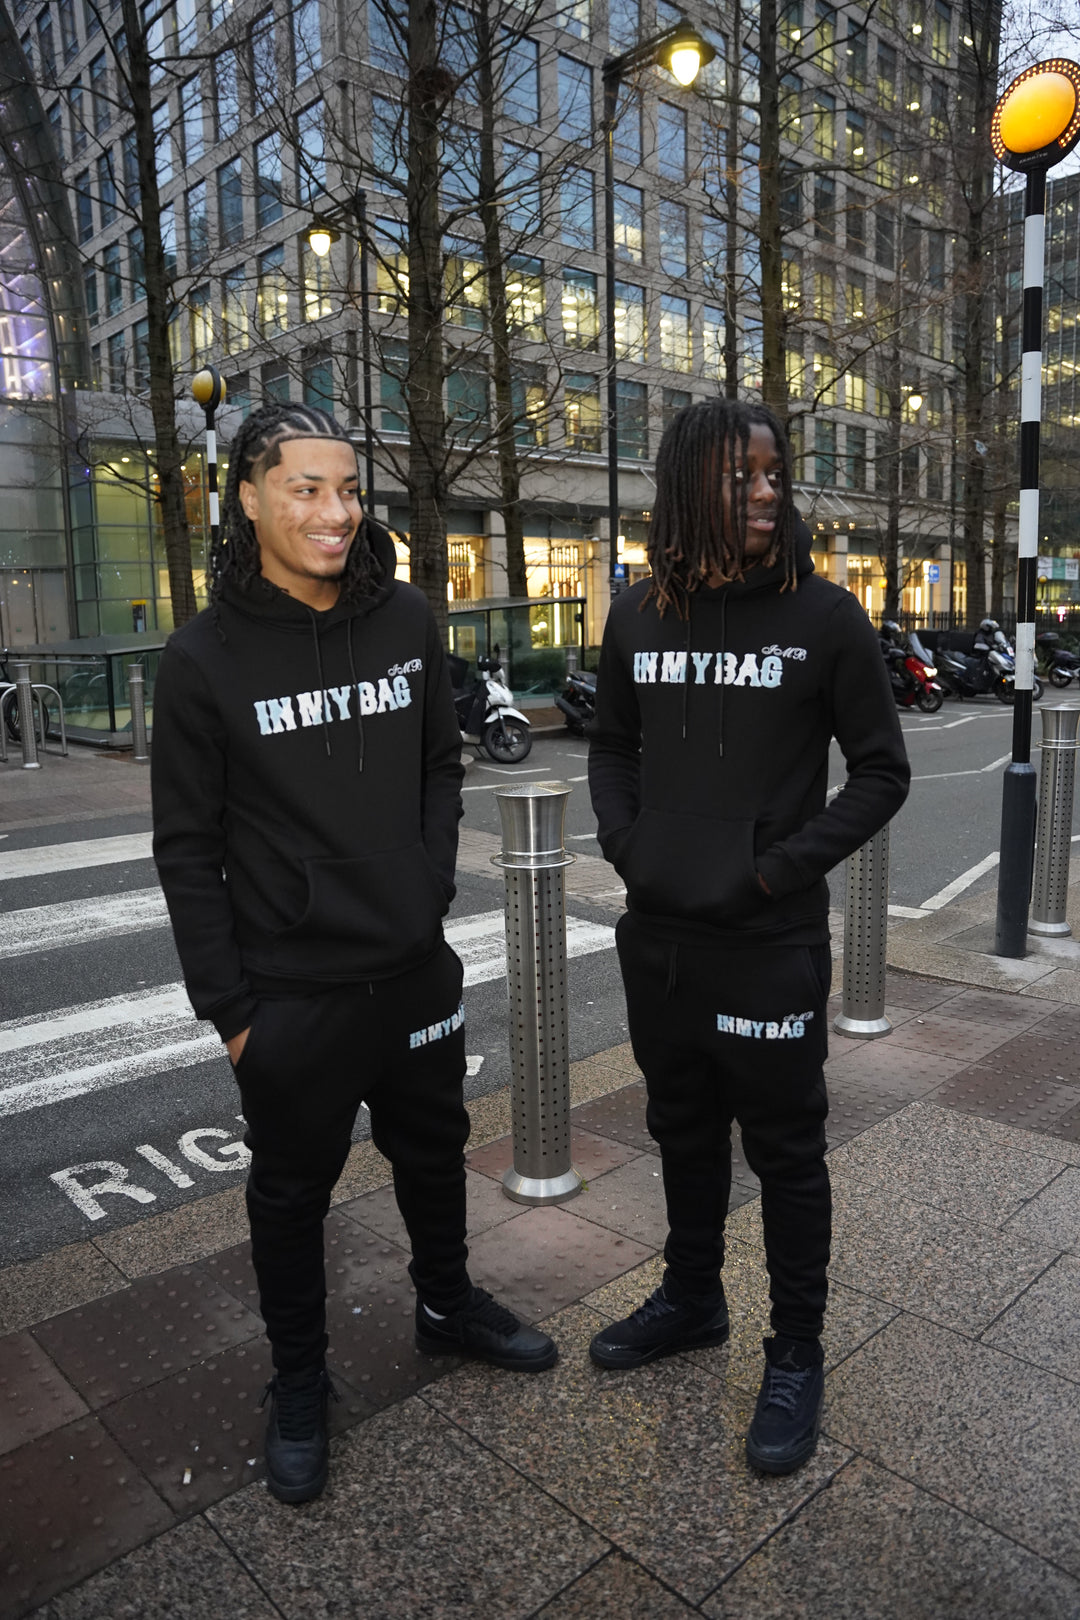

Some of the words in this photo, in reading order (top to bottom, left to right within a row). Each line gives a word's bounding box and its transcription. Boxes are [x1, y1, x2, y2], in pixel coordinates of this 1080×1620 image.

[633, 652, 659, 683] IN
[660, 651, 713, 684] MY
[714, 652, 783, 688] BAG
[253, 696, 297, 735] IN
[296, 685, 351, 727] MY
[353, 675, 412, 716] BAG
[717, 1013, 735, 1034] IN
[735, 1017, 765, 1039] MY
[765, 1020, 805, 1039] BAG
